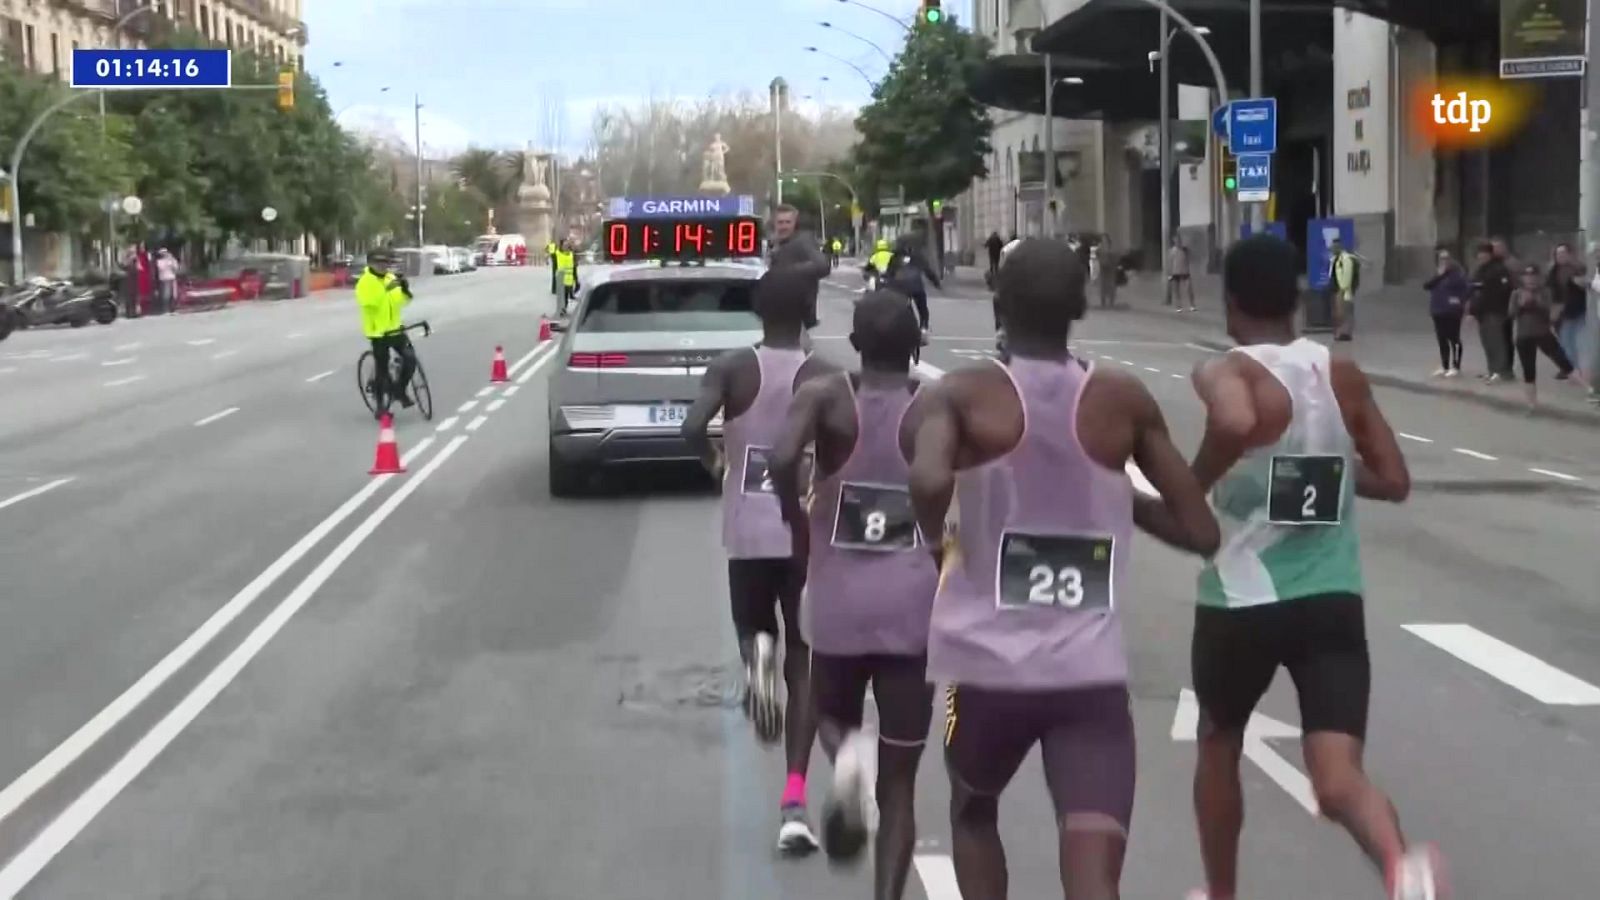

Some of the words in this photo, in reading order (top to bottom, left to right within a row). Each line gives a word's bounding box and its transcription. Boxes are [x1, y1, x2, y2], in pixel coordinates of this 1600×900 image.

[1240, 166, 1267, 177] TAXI
[643, 199, 720, 214] GARMIN
[610, 222, 755, 256] 01:14:18
[1302, 485, 1317, 517] 2
[864, 511, 887, 542] 8
[1029, 564, 1084, 607] 23
